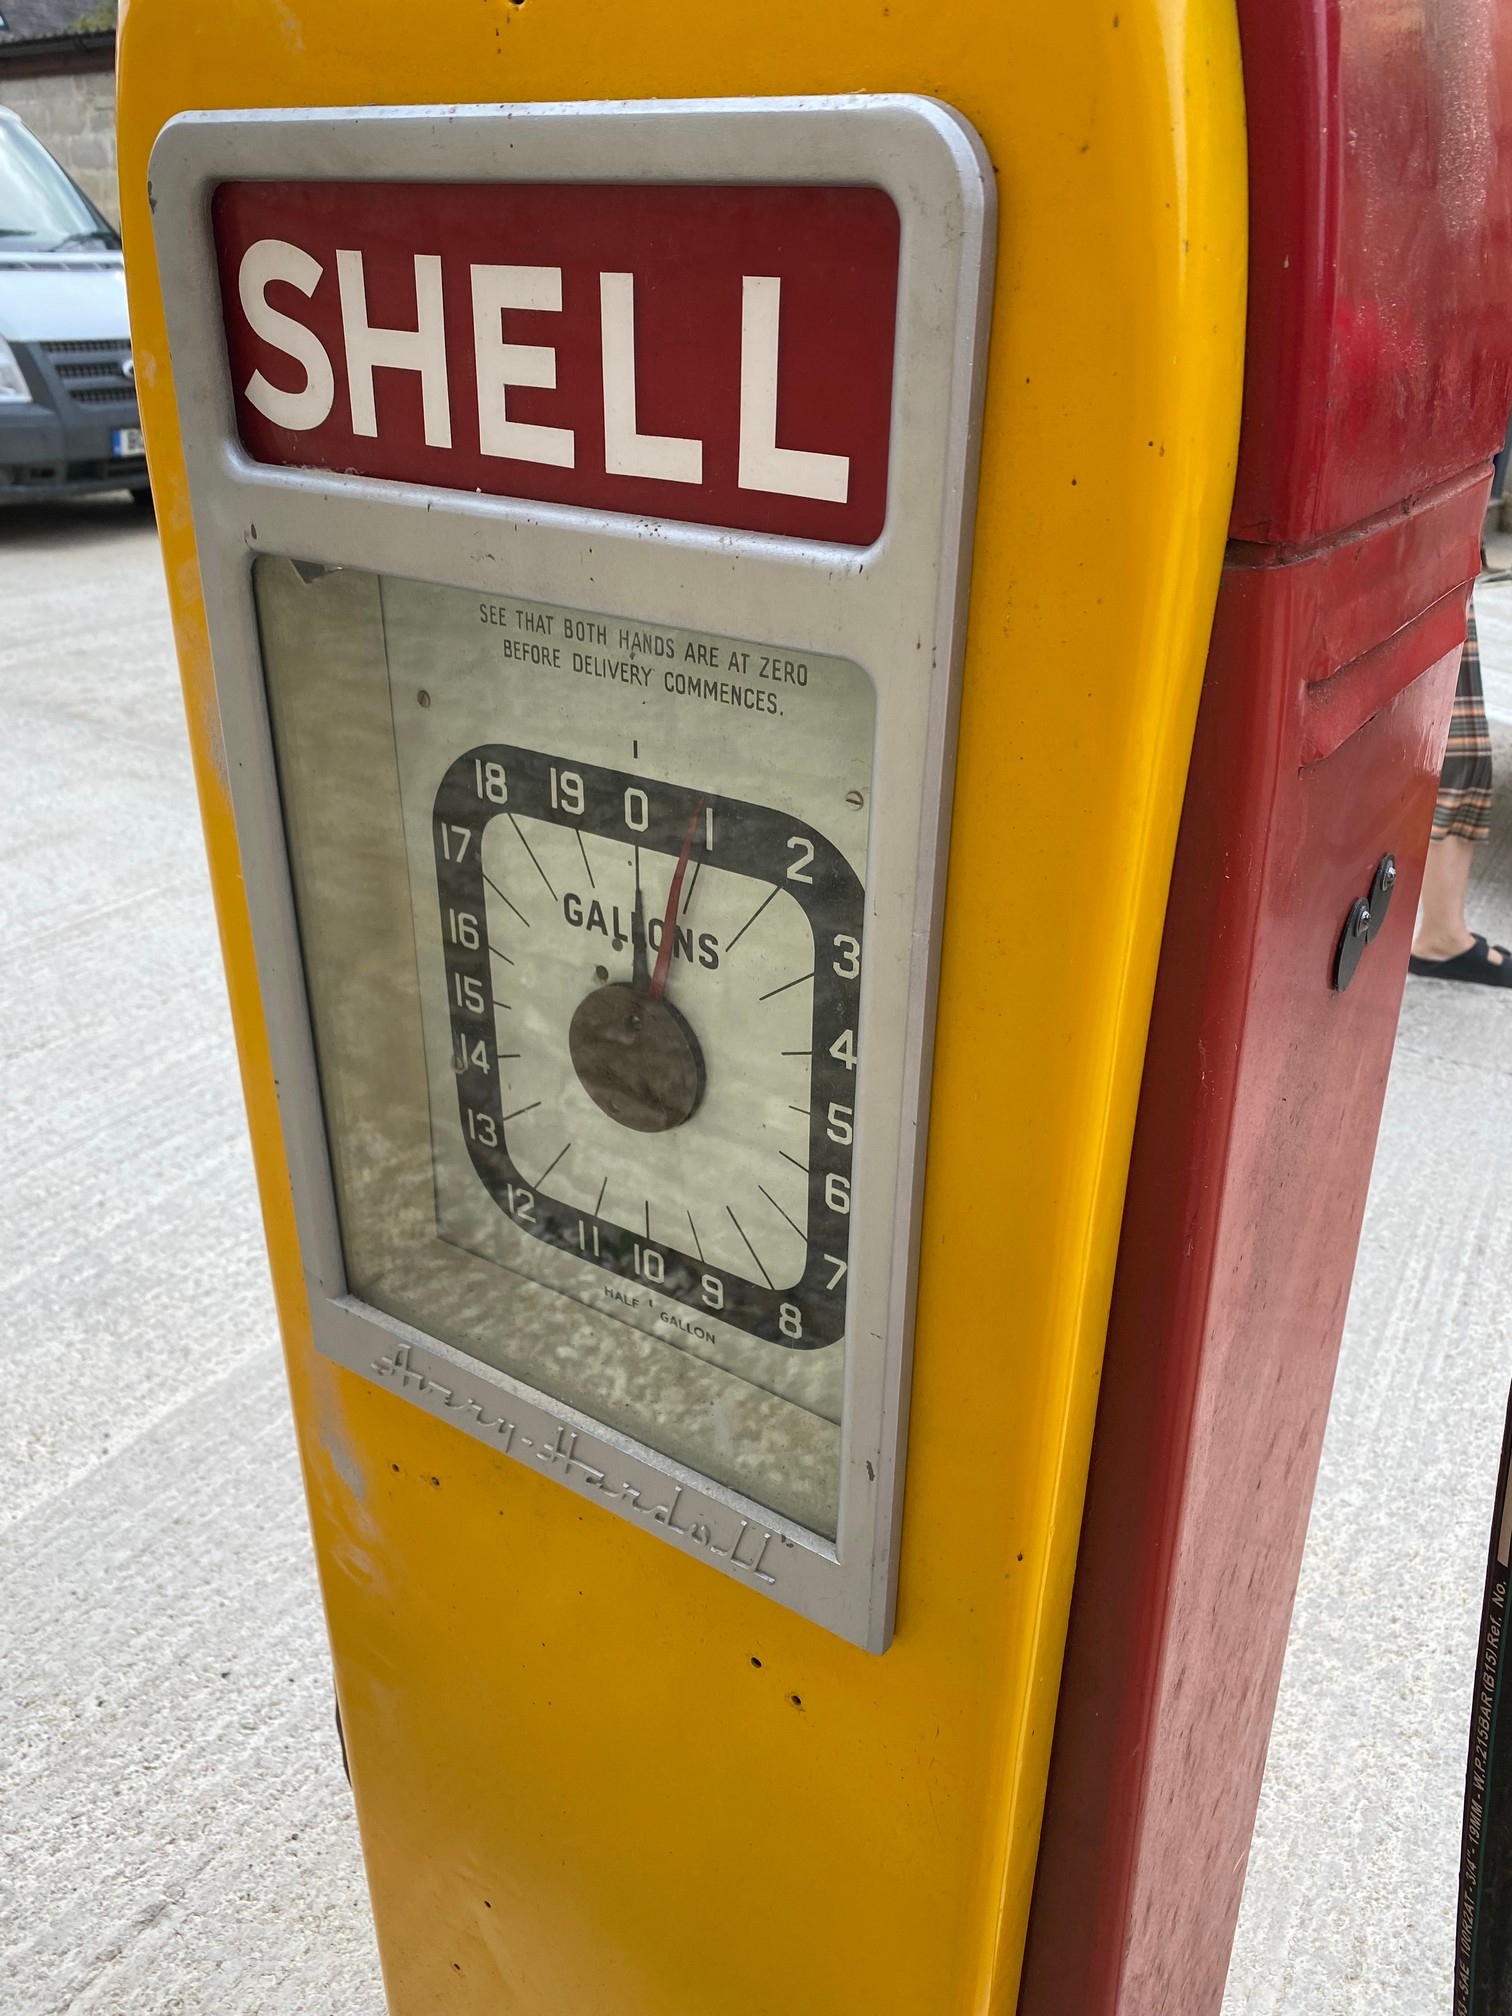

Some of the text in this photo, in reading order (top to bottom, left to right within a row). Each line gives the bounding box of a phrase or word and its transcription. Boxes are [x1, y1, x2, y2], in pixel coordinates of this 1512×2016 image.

[238, 239, 849, 503] SHELL
[480, 604, 808, 687] SEE THAT BOTH HANDS ARE AT ZERO
[503, 639, 784, 716] BEFORE DELIVERY COMMENCES.
[475, 759, 508, 804] 18
[550, 767, 585, 815] 19
[624, 787, 649, 833] 0
[705, 807, 713, 851] 1
[441, 822, 472, 863] 17
[786, 836, 815, 885] 2
[449, 908, 480, 949] 16
[833, 934, 861, 979] 3
[455, 973, 484, 1014] 15
[460, 1033, 490, 1075] 14
[829, 1029, 857, 1071] 4
[467, 1108, 498, 1148] 13
[826, 1102, 854, 1145] 5
[507, 1183, 536, 1224] 12
[824, 1173, 851, 1215] 6
[578, 1220, 600, 1257] 11
[633, 1244, 665, 1284] 10
[823, 1253, 848, 1291] 7
[701, 1274, 724, 1311] 9
[604, 1286, 716, 1345] HALF GALLON
[779, 1303, 802, 1340] 8
